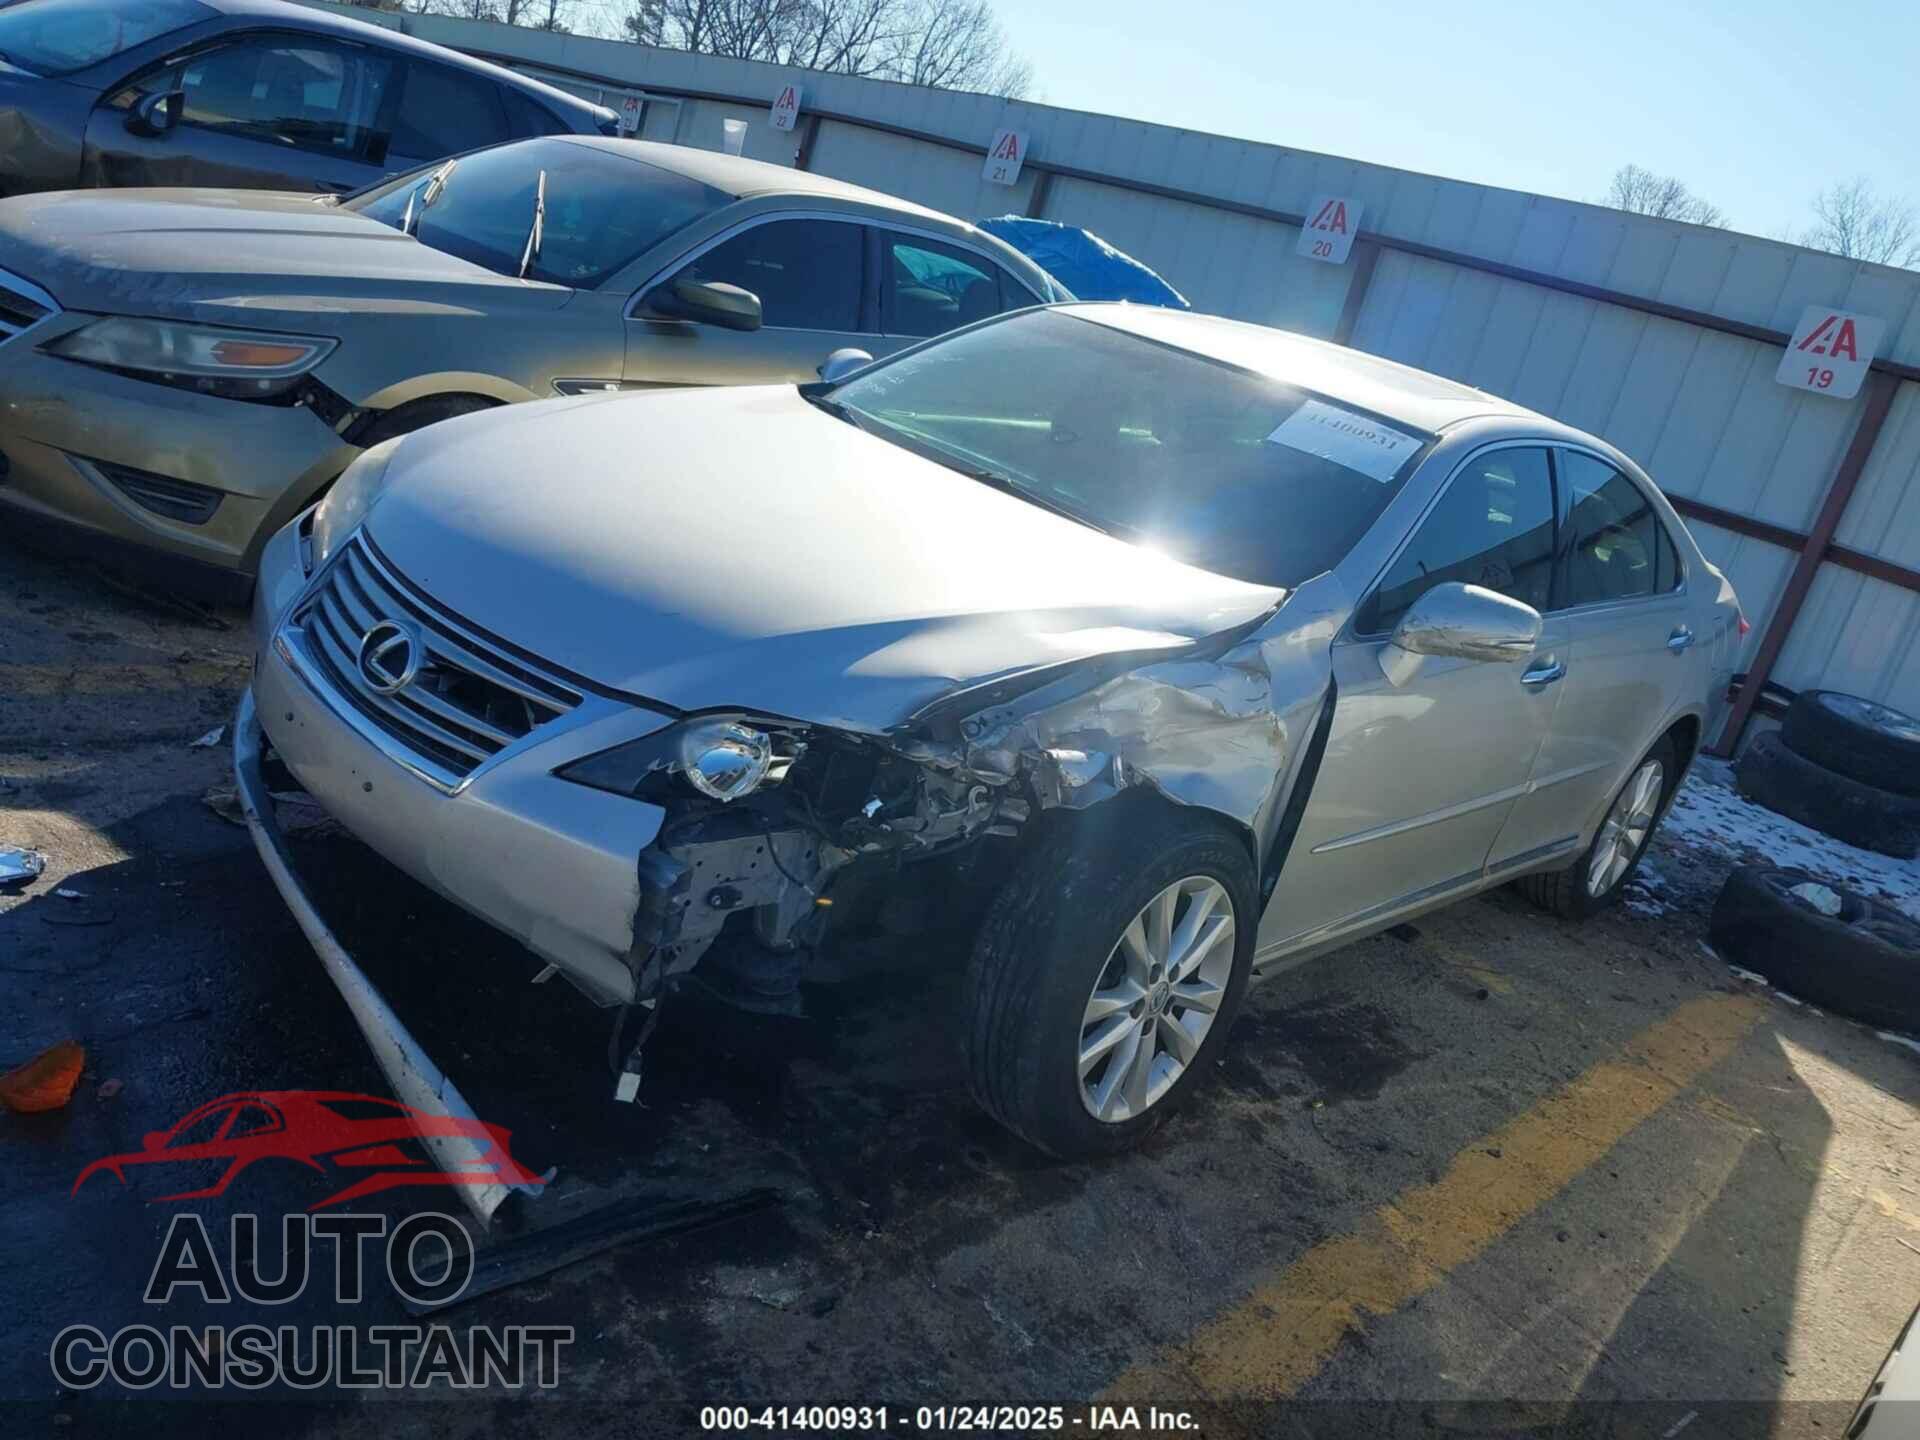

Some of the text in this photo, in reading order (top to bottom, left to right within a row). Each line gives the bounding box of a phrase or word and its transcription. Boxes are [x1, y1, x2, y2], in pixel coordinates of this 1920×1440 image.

[992, 166, 1007, 180] 21
[1312, 240, 1333, 257] 20
[1808, 367, 1834, 388] 19
